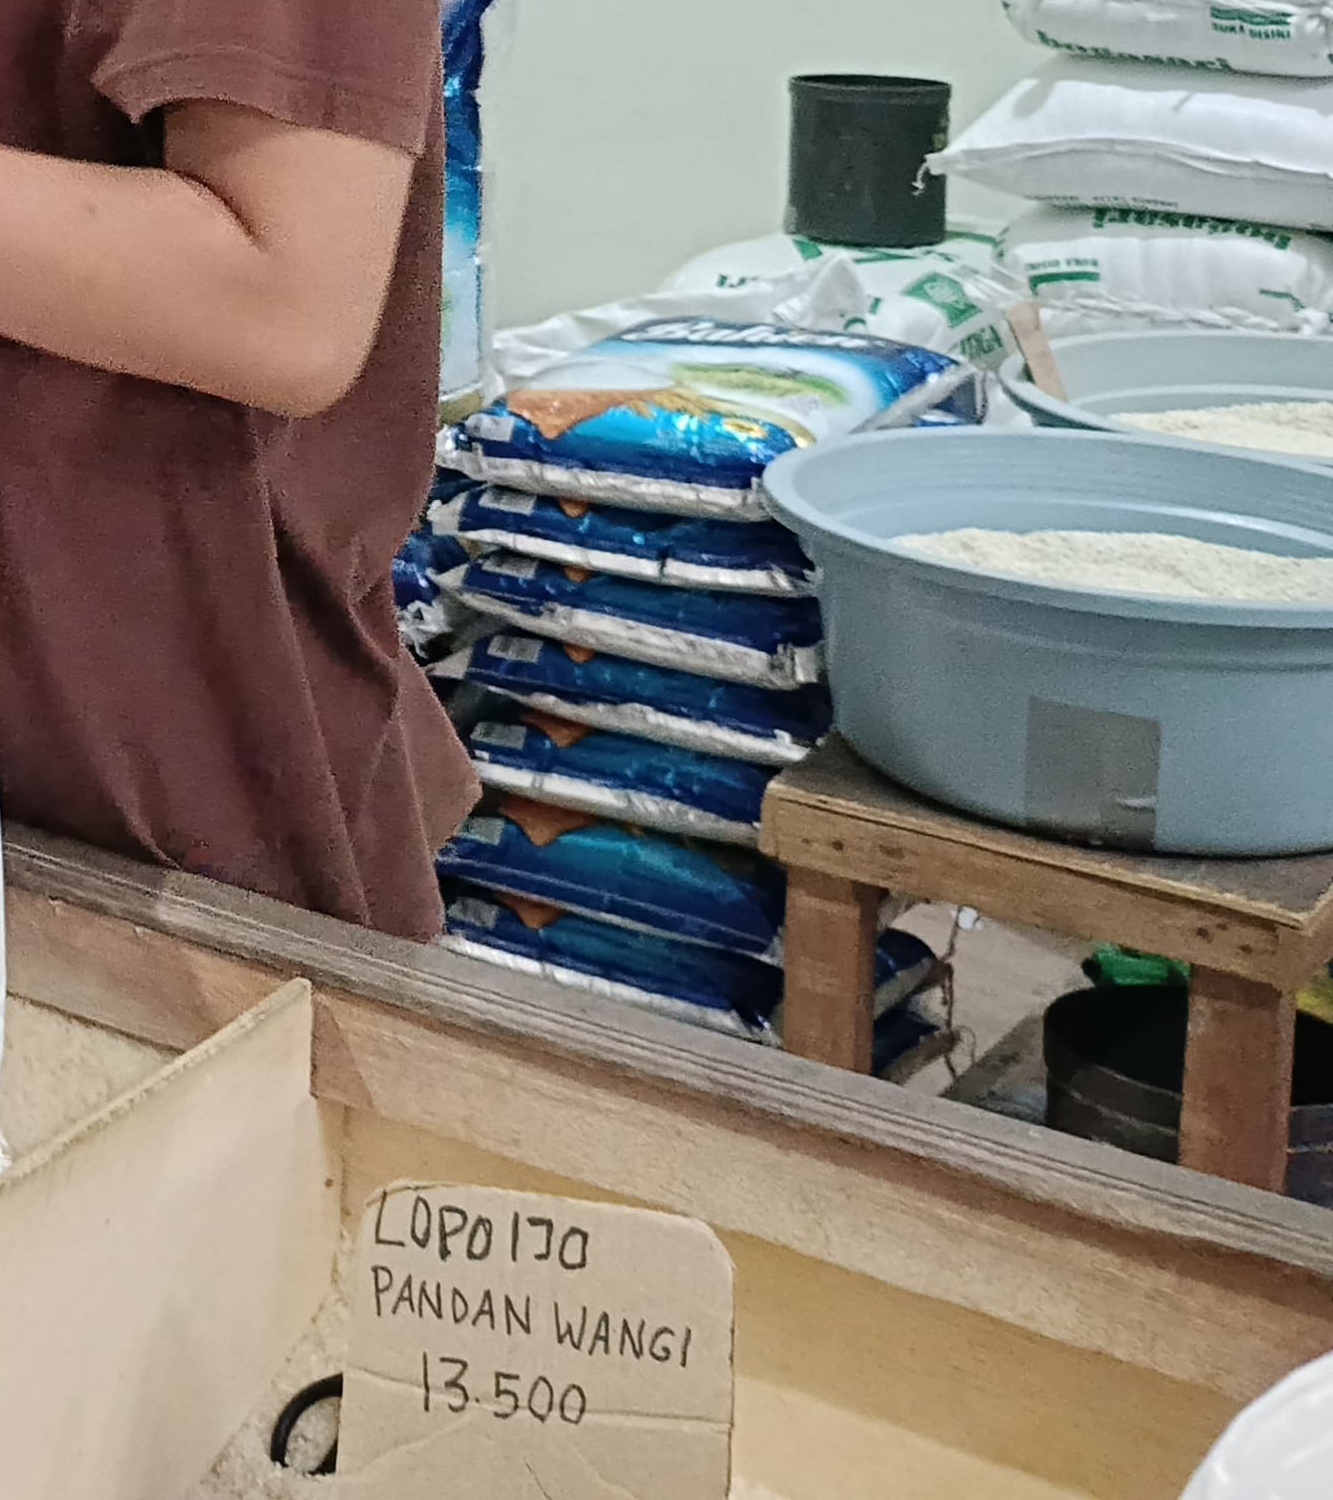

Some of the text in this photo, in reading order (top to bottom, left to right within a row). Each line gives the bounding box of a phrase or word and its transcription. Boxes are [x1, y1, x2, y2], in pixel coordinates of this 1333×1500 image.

[374, 1190, 493, 1262] LOPO
[371, 1264, 693, 1368] PANDAN WANGI
[421, 1350, 587, 1425] 13.500
